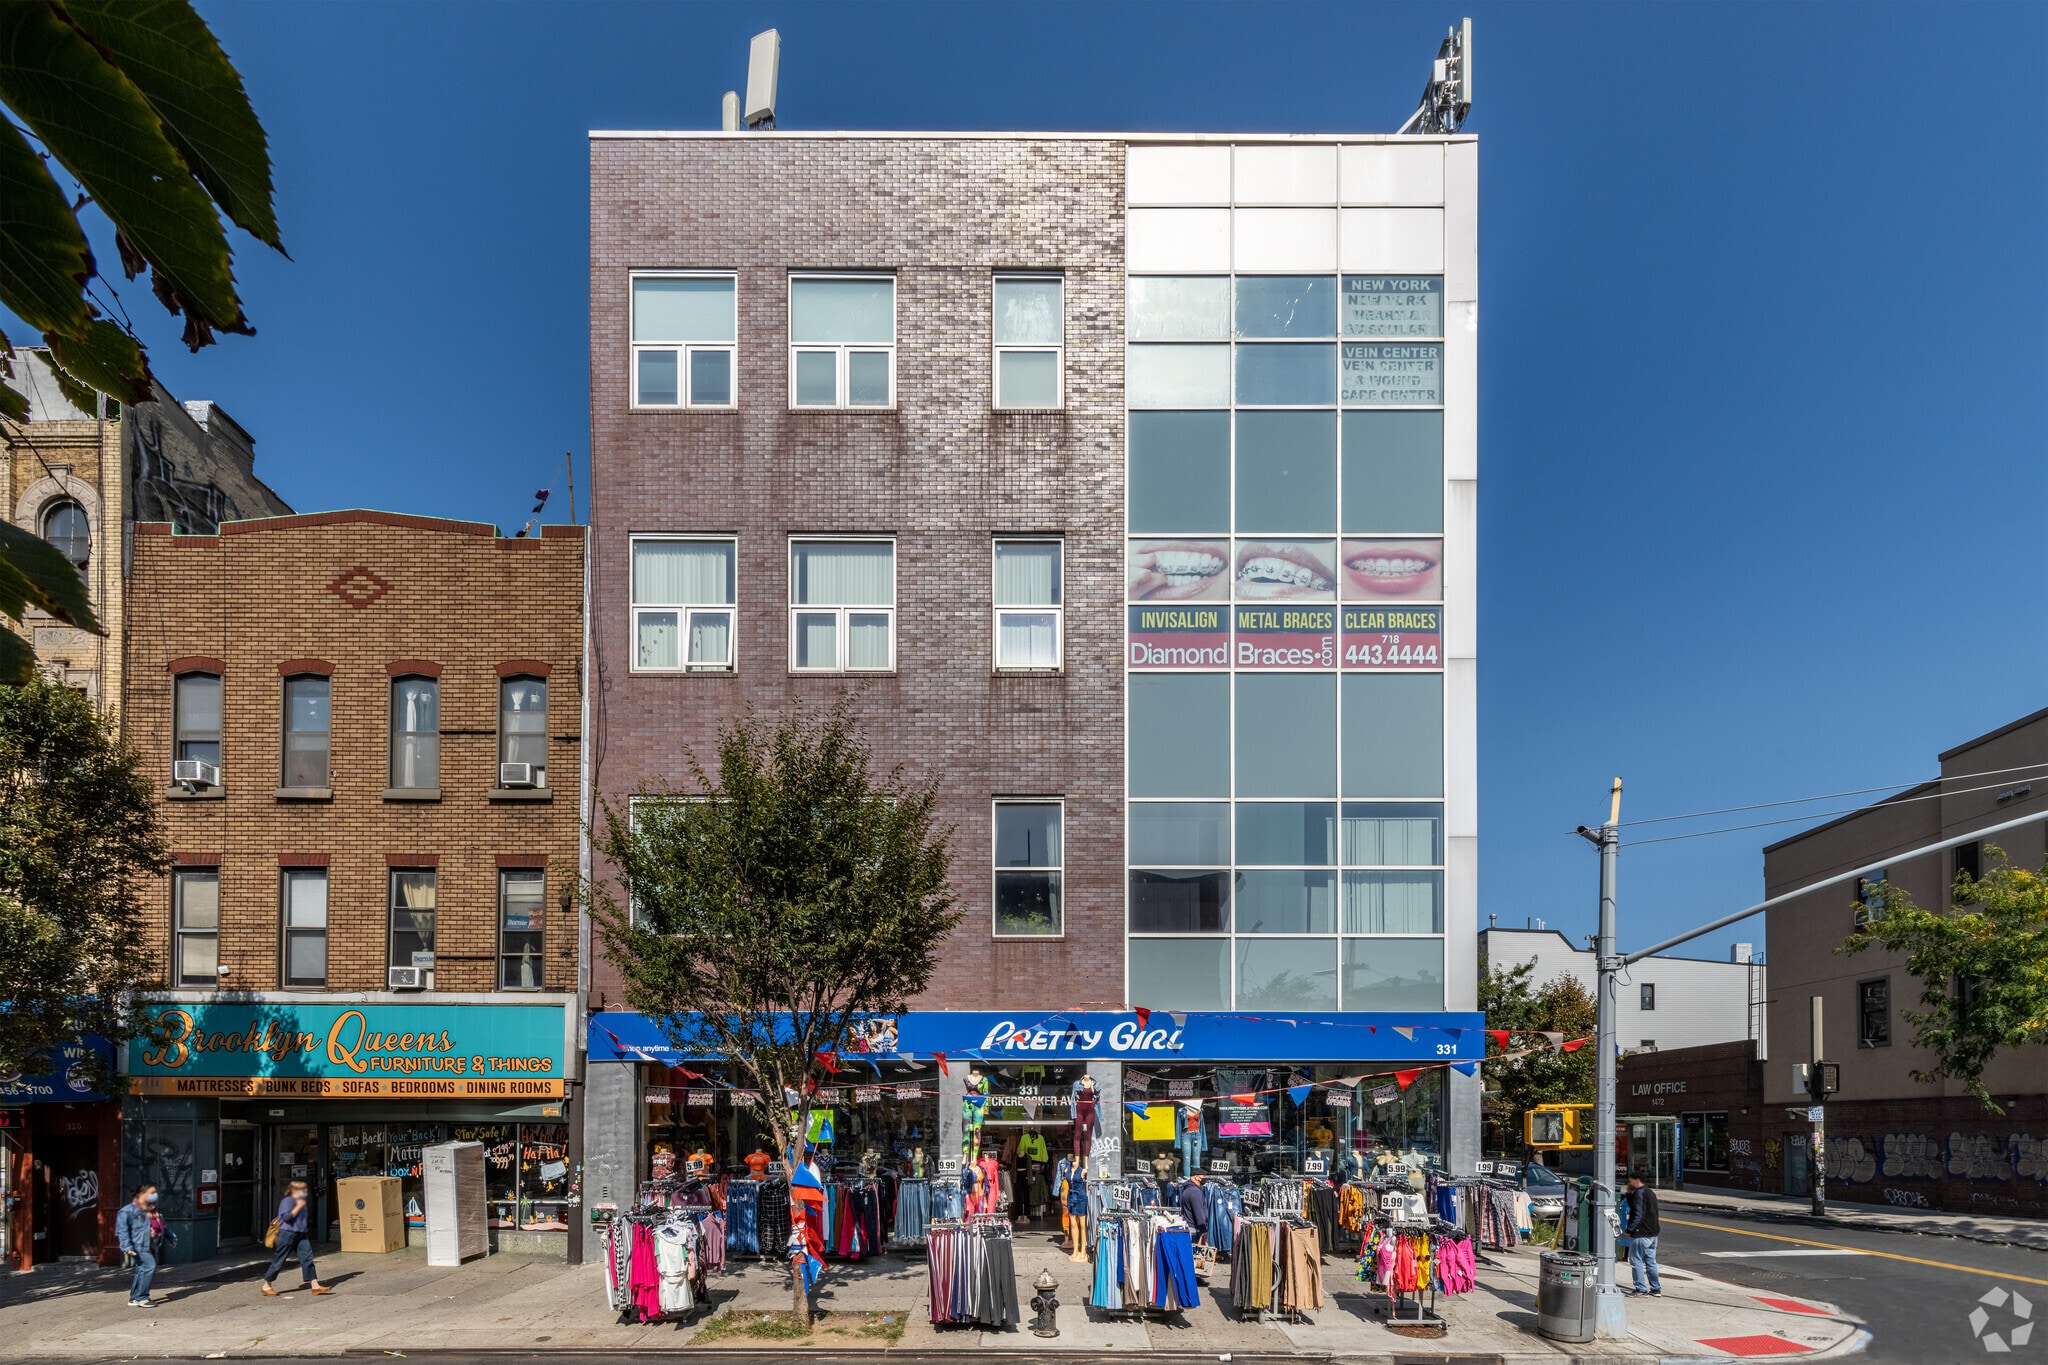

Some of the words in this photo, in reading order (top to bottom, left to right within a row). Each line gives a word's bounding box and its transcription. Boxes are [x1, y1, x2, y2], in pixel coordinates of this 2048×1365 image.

[1351, 280, 1385, 291] NEW
[1389, 280, 1431, 291] YORK
[1345, 347, 1378, 358] VEIN
[1382, 347, 1438, 358] CENTER
[1342, 361, 1375, 371] VEIN
[1141, 611, 1218, 629] INVISALIGN
[1238, 612, 1281, 629] METAL
[1283, 612, 1332, 629] BRACES
[1345, 613, 1385, 629] CLEAR
[1388, 613, 1436, 629] BRACES
[1382, 635, 1400, 645] 718
[1130, 641, 1228, 665] Diamond
[1345, 644, 1438, 665] 443.4444
[980, 1021, 1103, 1050] PRETTY
[1109, 1021, 1185, 1050] GIRL
[142, 1010, 321, 1069] Brooklyn
[326, 1010, 457, 1073] Queens
[642, 1044, 670, 1053] anytime
[1436, 1043, 1457, 1055] 331
[368, 1055, 466, 1073] FURNITURE
[471, 1056, 486, 1073] &
[486, 1056, 552, 1073] THINGS
[177, 1079, 254, 1093] MATTRESSES
[265, 1080, 298, 1093] BUNK
[301, 1080, 331, 1093] BEDS
[342, 1080, 380, 1093] SOFAS
[391, 1080, 455, 1093] BEDROOMS
[466, 1080, 507, 1093] DINING
[510, 1080, 552, 1093] ROOMS
[1019, 1085, 1039, 1096] 331
[1632, 1083, 1652, 1096] LAW
[1654, 1081, 1687, 1094] OFFICE
[1168, 1089, 1194, 1097] OPENING
[1651, 1098, 1665, 1106] 1472
[388, 1131, 408, 1143] Your
[686, 1160, 704, 1171] 5.99
[939, 1160, 955, 1170] 9.99
[1137, 1161, 1150, 1171] 7.99
[1212, 1160, 1229, 1171] 9.99
[1306, 1162, 1323, 1171] 7.99
[1388, 1165, 1406, 1173] 5.99
[1477, 1164, 1492, 1172] 1.99
[1498, 1164, 1504, 1172] 3
[1505, 1165, 1516, 1174] $10
[1114, 1187, 1131, 1200] 3.99
[1244, 1190, 1260, 1203] 5.99
[1382, 1197, 1403, 1208] 9.99
